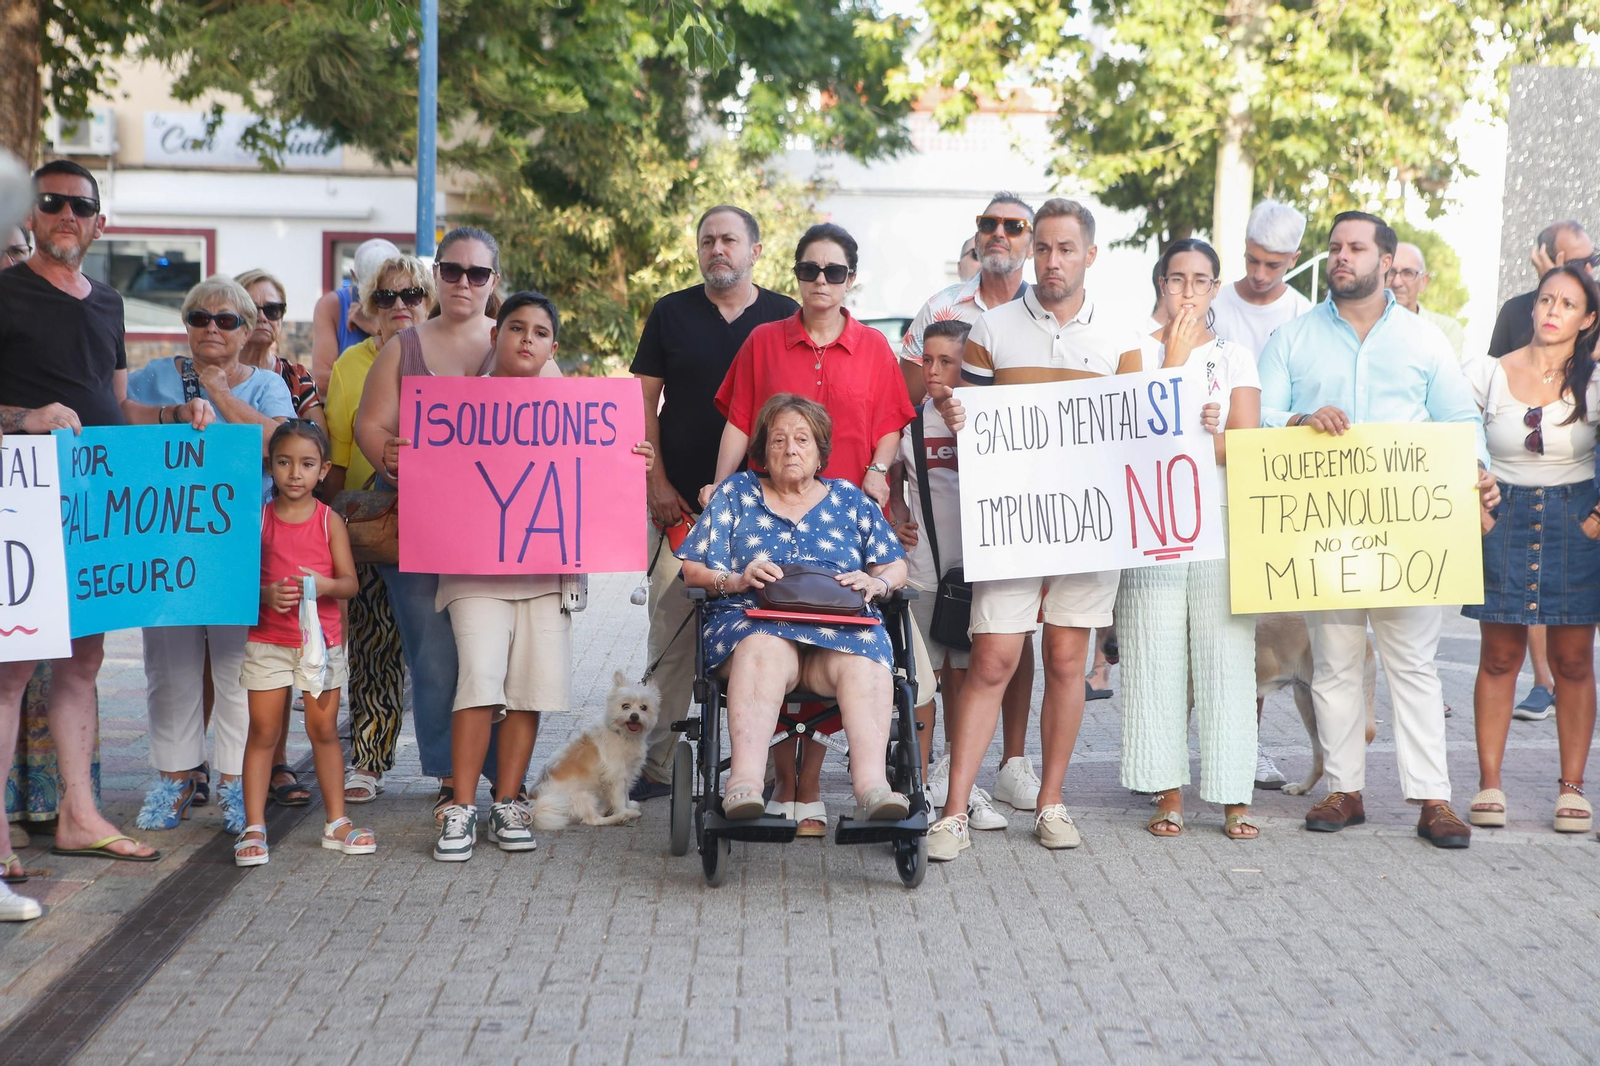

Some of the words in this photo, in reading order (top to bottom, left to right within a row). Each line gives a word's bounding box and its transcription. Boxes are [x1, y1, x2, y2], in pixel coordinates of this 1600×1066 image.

[413, 389, 618, 449] ¡SOLUCIONES
[974, 405, 1049, 455] SALUD
[1058, 388, 1147, 447] MENTAL
[1147, 377, 1183, 437] SI
[71, 444, 114, 478] POR
[164, 438, 206, 470] UN
[1262, 445, 1378, 483] ¡QUEREMOS
[60, 483, 235, 545] PALMONES
[475, 457, 582, 568] YA!
[977, 486, 1114, 547] IMPUNIDAD
[1125, 453, 1202, 549] NO
[1249, 484, 1453, 535] TRANQUILOS
[1314, 537, 1342, 553] NO
[1351, 531, 1388, 551] CON
[75, 556, 196, 600] SEGURO
[1265, 549, 1448, 600] MIEDO!
